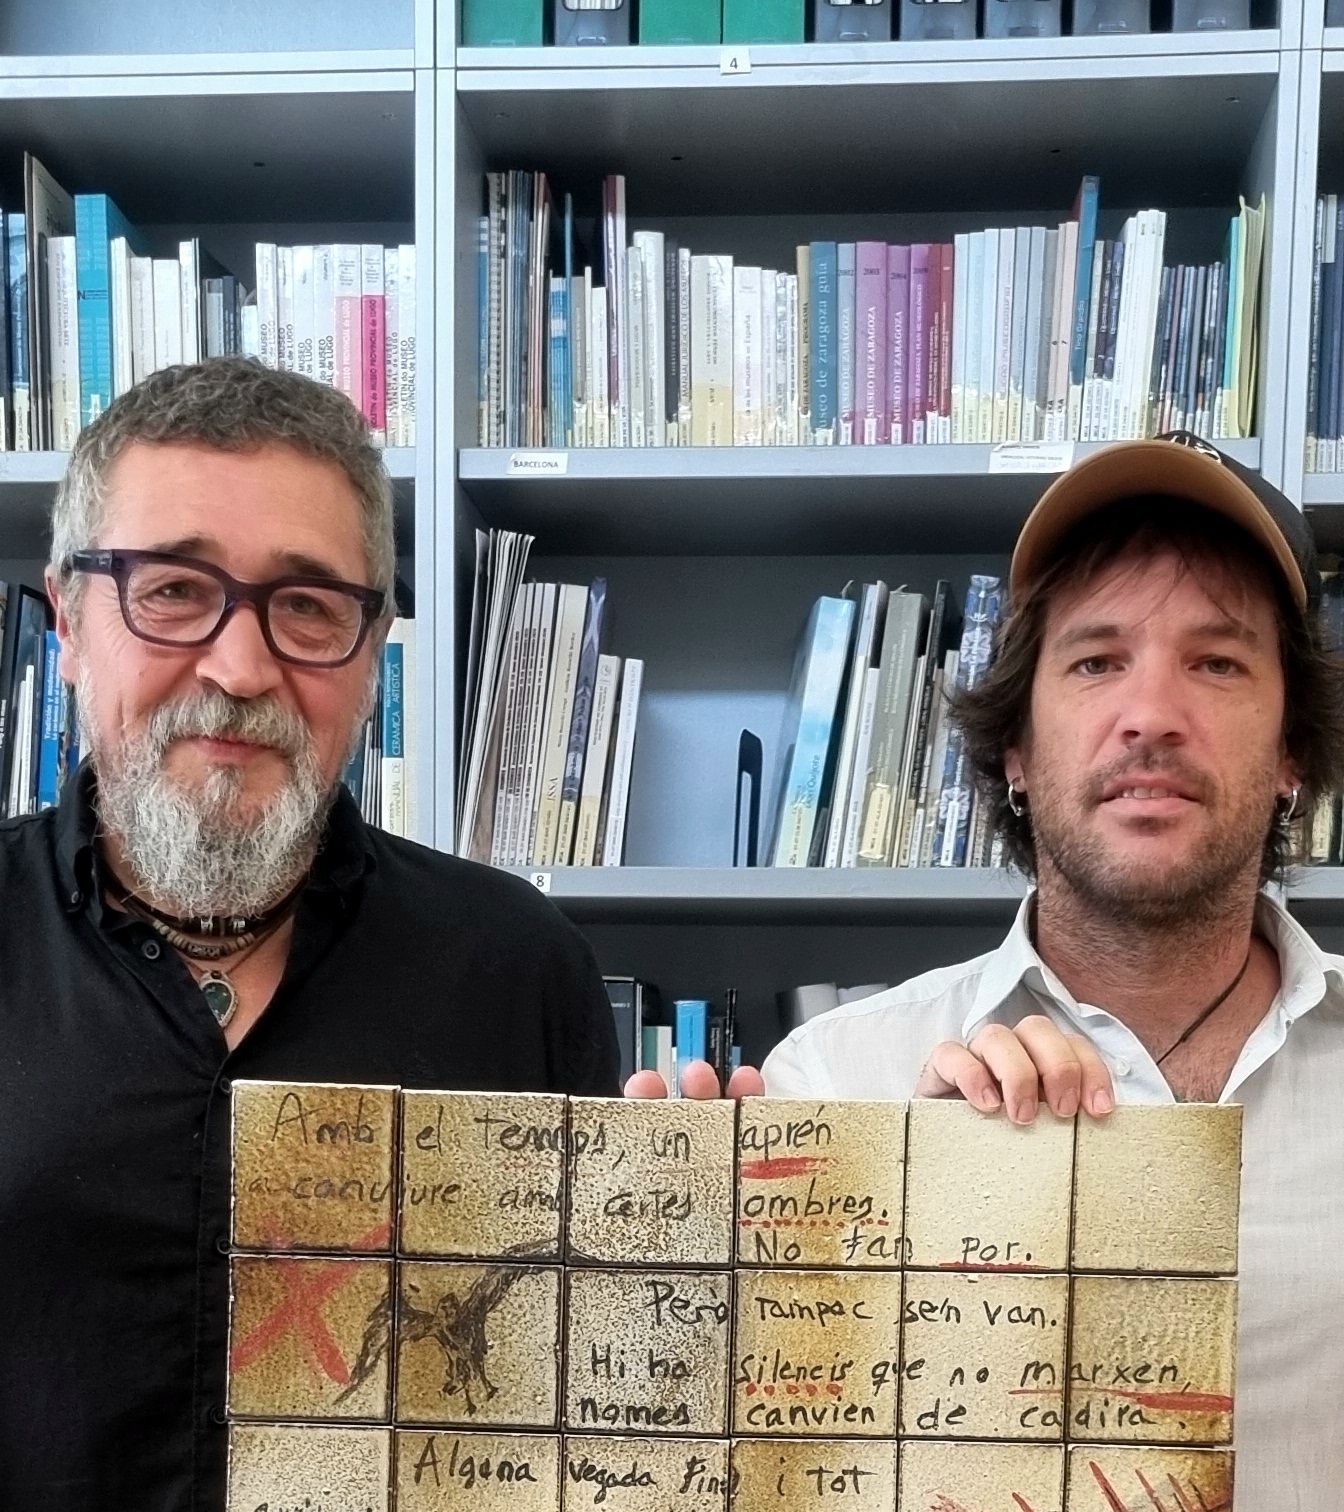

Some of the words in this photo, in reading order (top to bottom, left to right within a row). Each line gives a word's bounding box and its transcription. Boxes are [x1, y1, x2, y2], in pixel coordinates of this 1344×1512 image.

[729, 57, 738, 69] 4
[815, 394, 829, 432] useo
[513, 460, 559, 468] BARCELONA
[536, 875, 545, 887] 8
[271, 1092, 375, 1146] Amb
[415, 1105, 445, 1156] el
[754, 1229, 803, 1264] No
[949, 1366, 991, 1388] no
[916, 1397, 968, 1432] de
